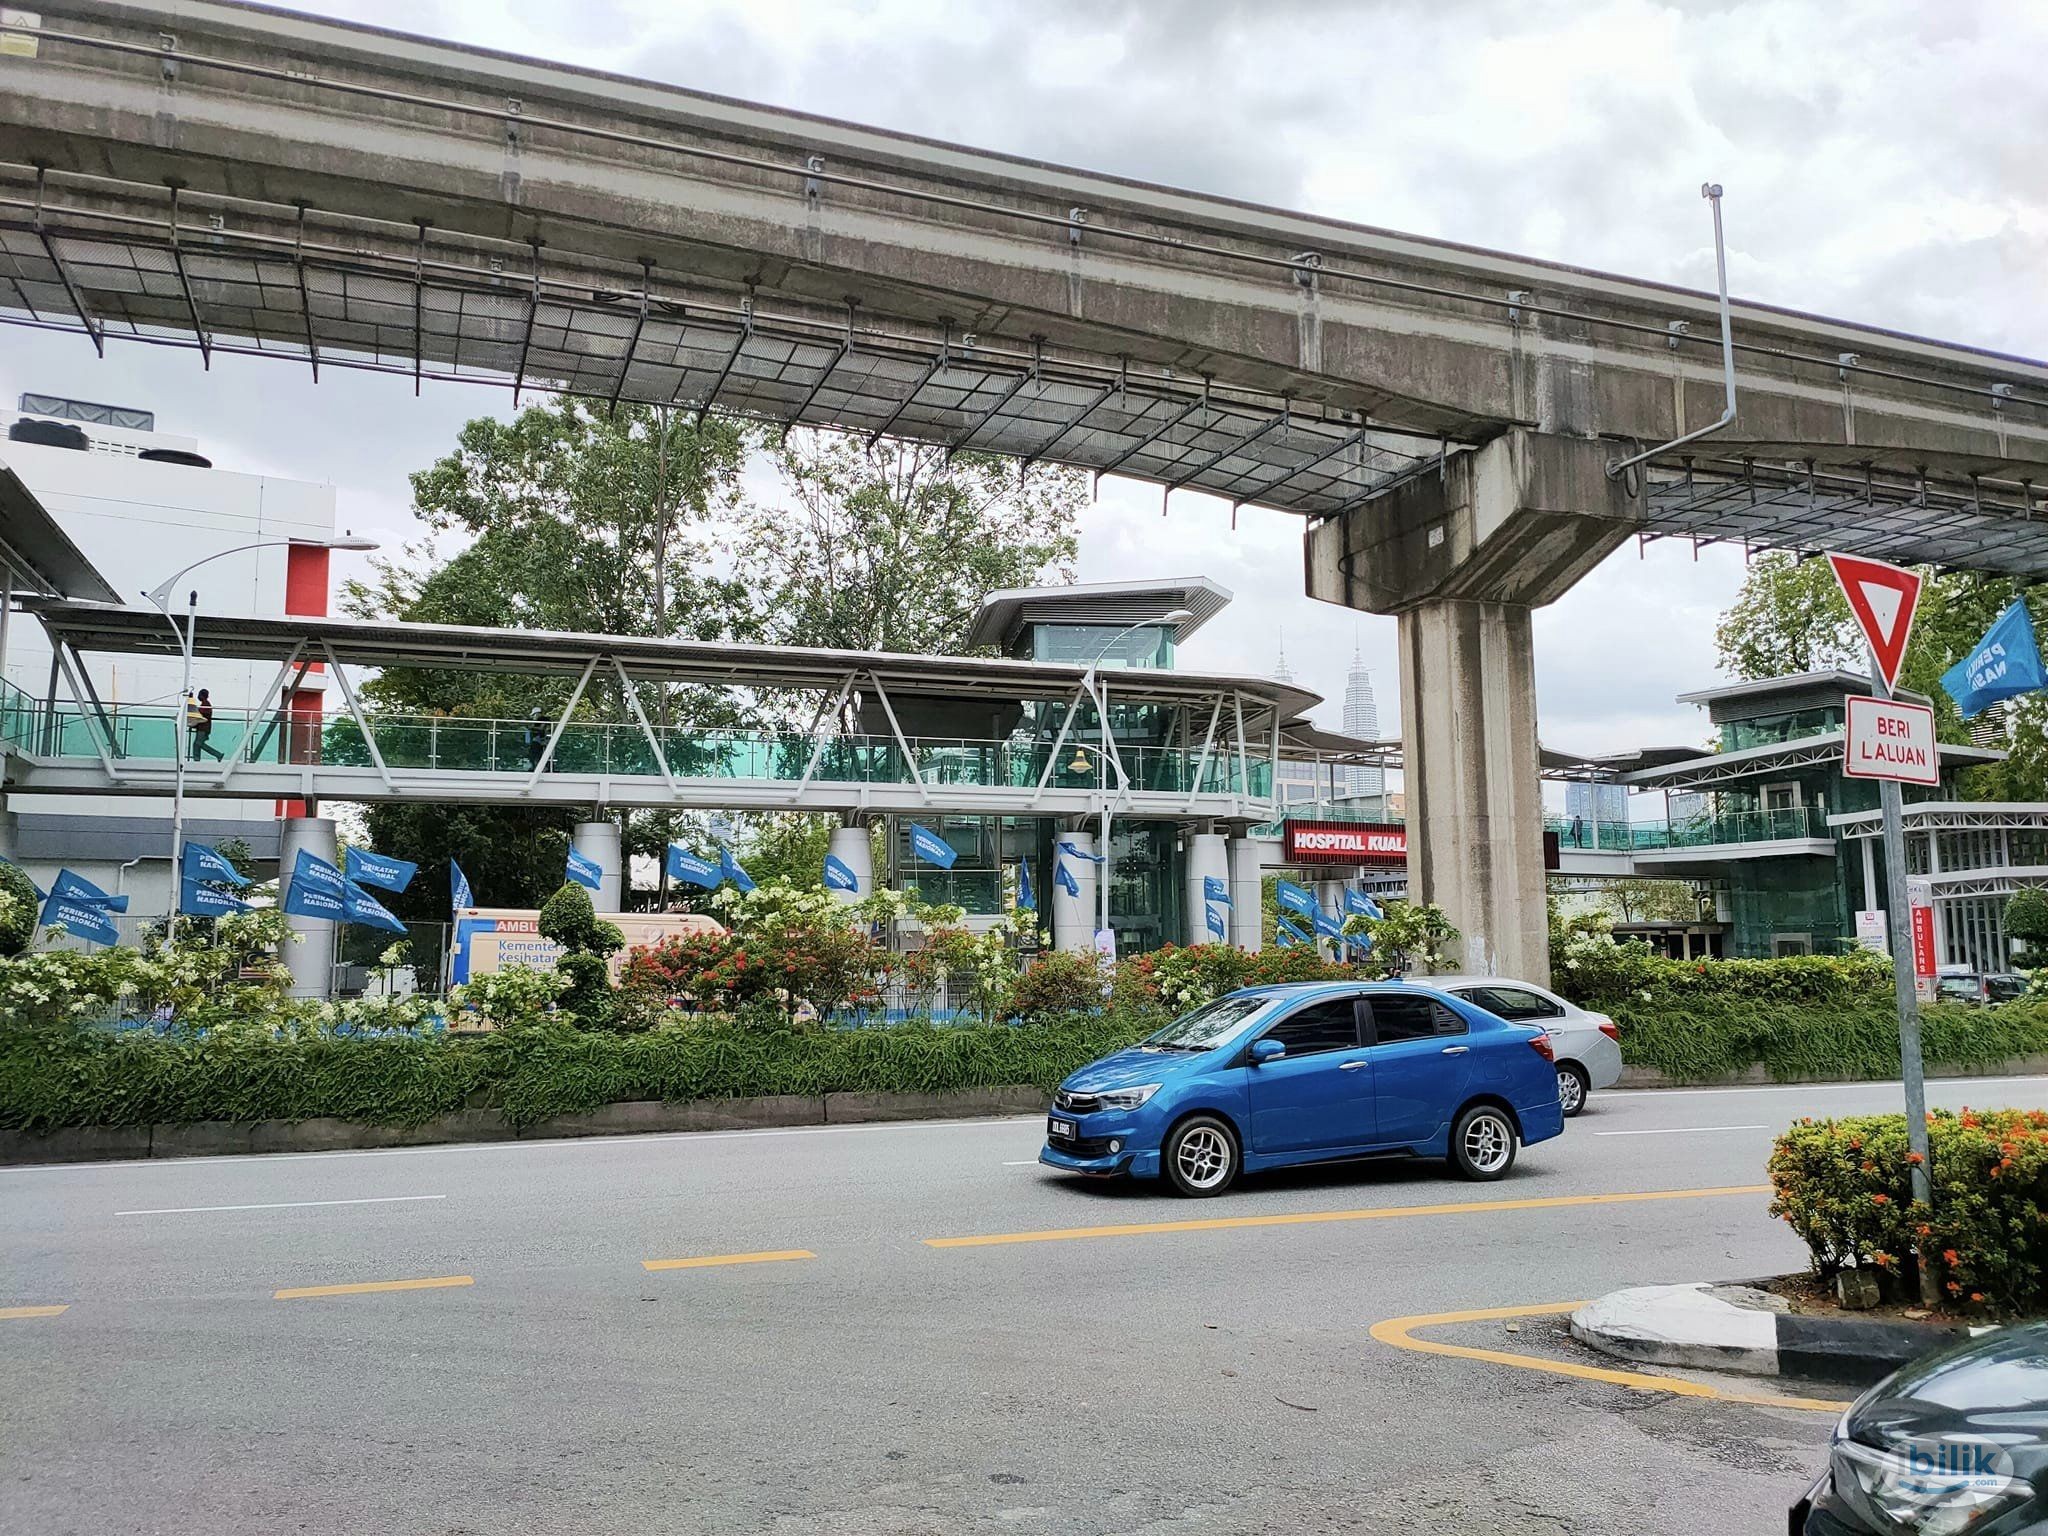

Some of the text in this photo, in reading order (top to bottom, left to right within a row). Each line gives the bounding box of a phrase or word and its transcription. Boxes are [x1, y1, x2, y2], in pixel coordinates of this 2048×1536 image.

[1877, 716, 1910, 738] BERI
[1861, 741, 1926, 767] LALUAN
[1294, 832, 1407, 852] HOSPITAL KUAL
[57, 911, 101, 930] NASIONAL
[58, 905, 105, 924] PERIKATAN
[496, 920, 539, 932] AMBU
